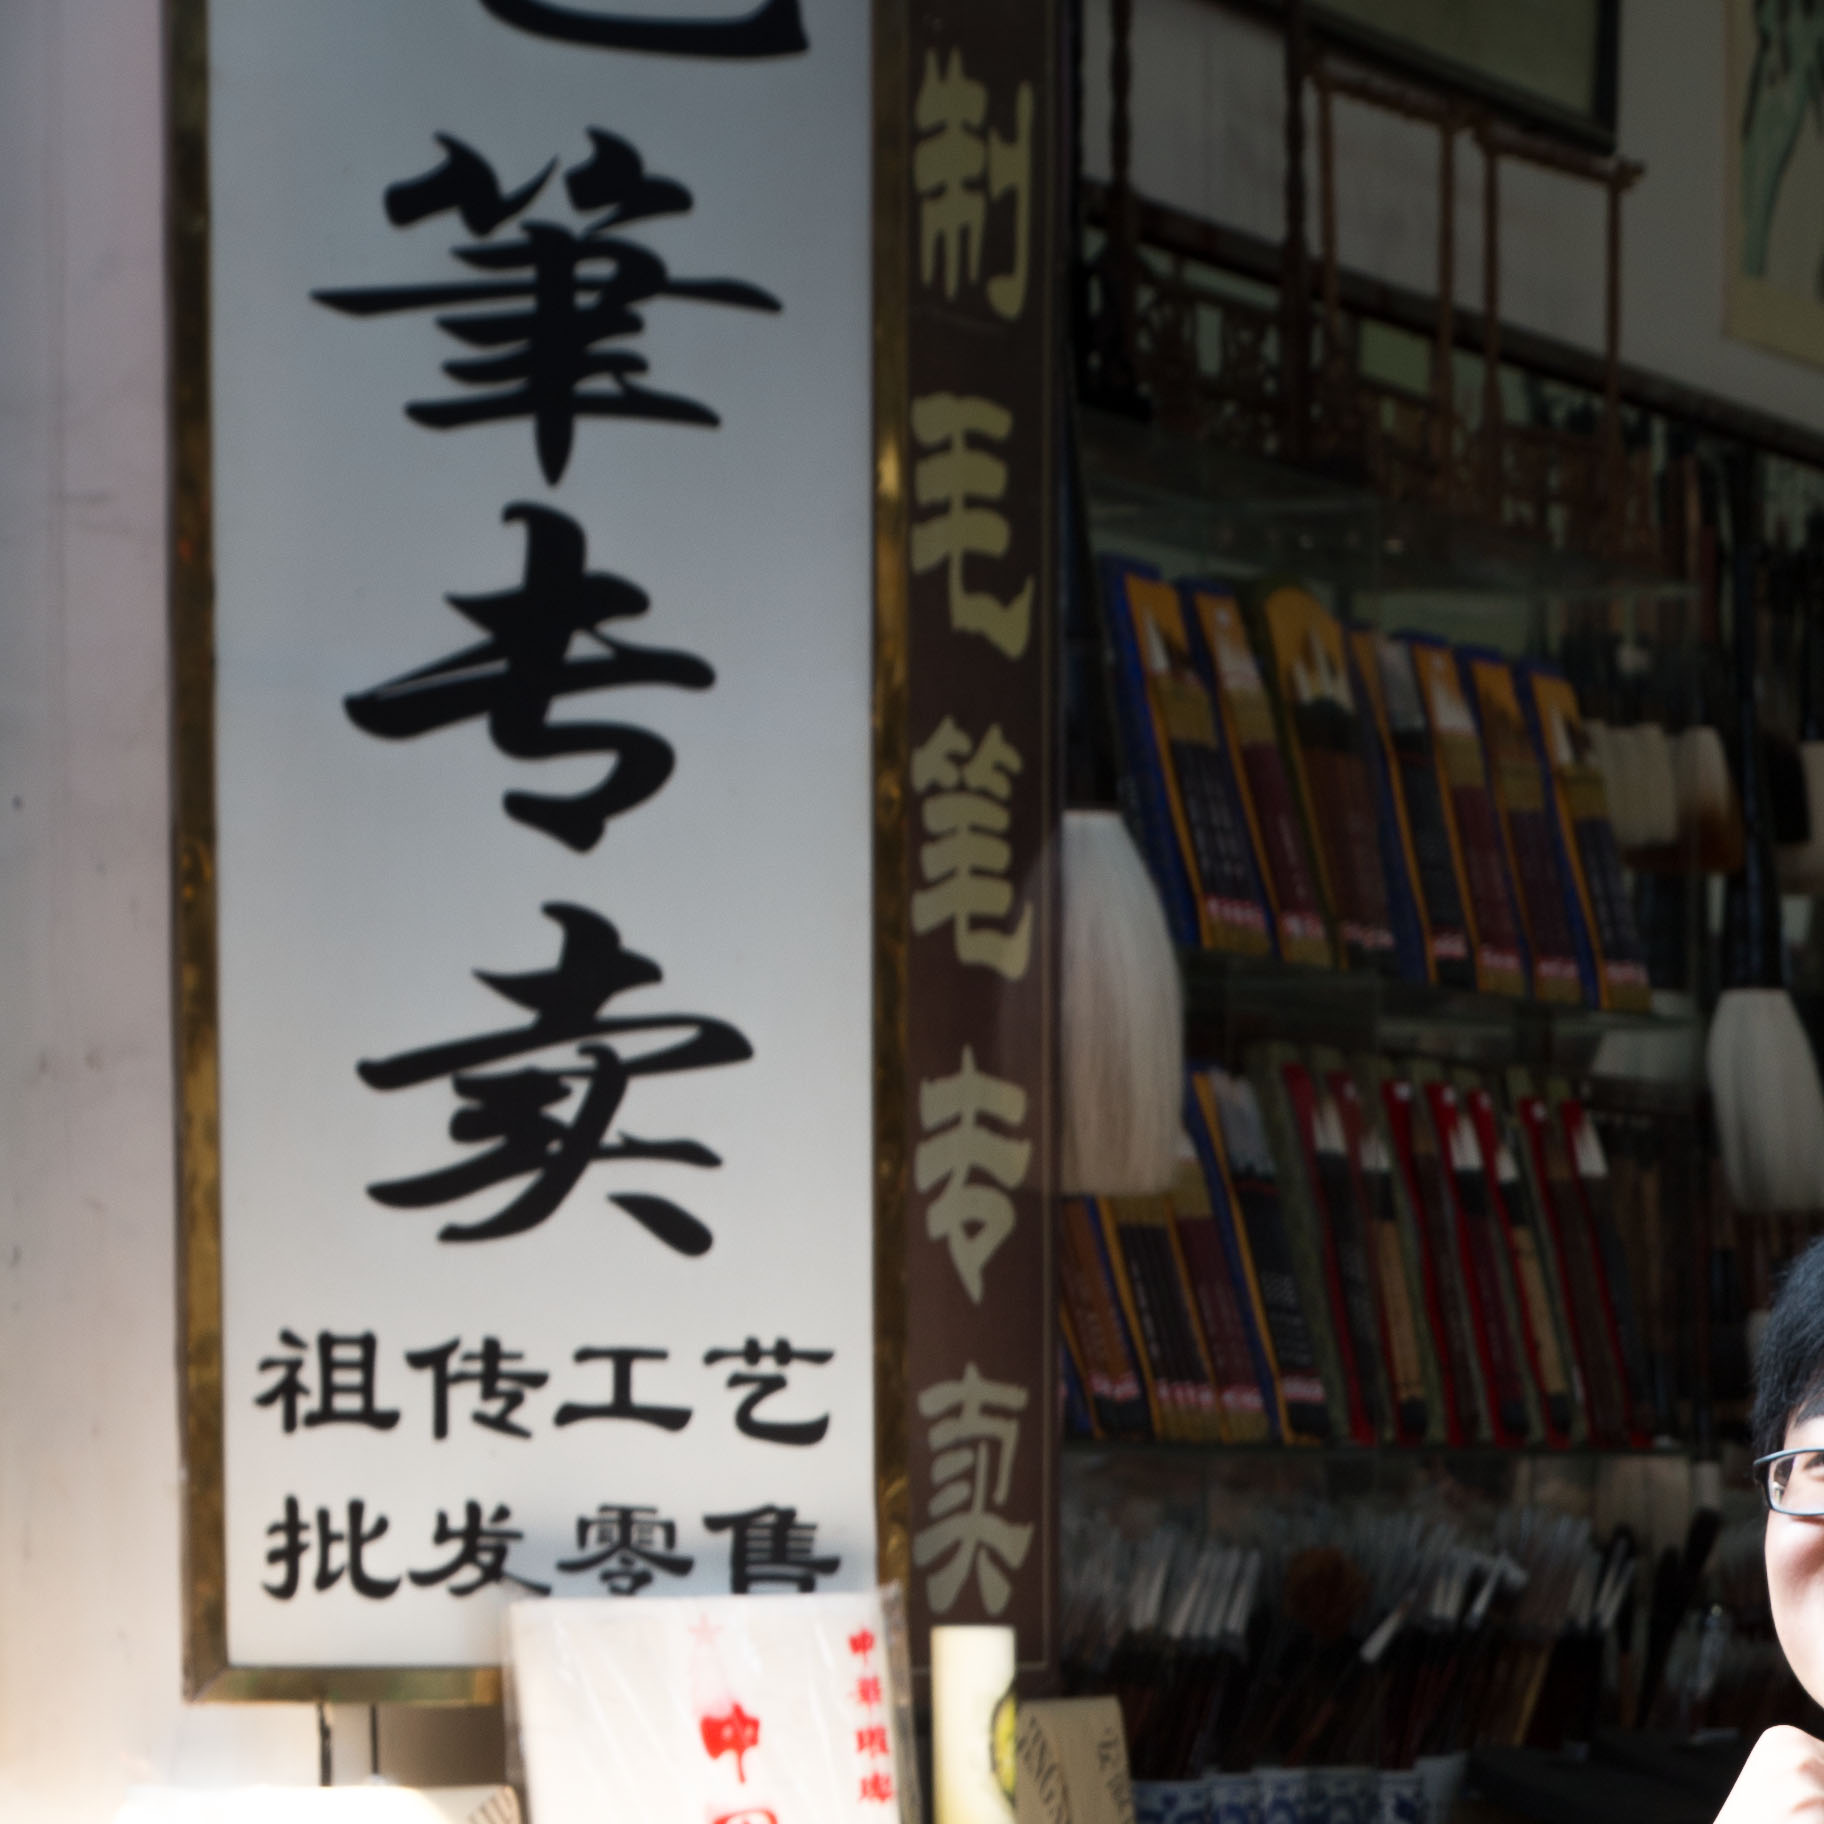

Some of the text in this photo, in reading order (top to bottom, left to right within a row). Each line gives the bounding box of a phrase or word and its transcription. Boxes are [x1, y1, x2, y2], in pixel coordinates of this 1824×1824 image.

[910, 45, 1035, 1614] 制毛笔专卖
[254, 1329, 835, 1447] 祖传工艺
[260, 1494, 842, 1600] 批发零售
